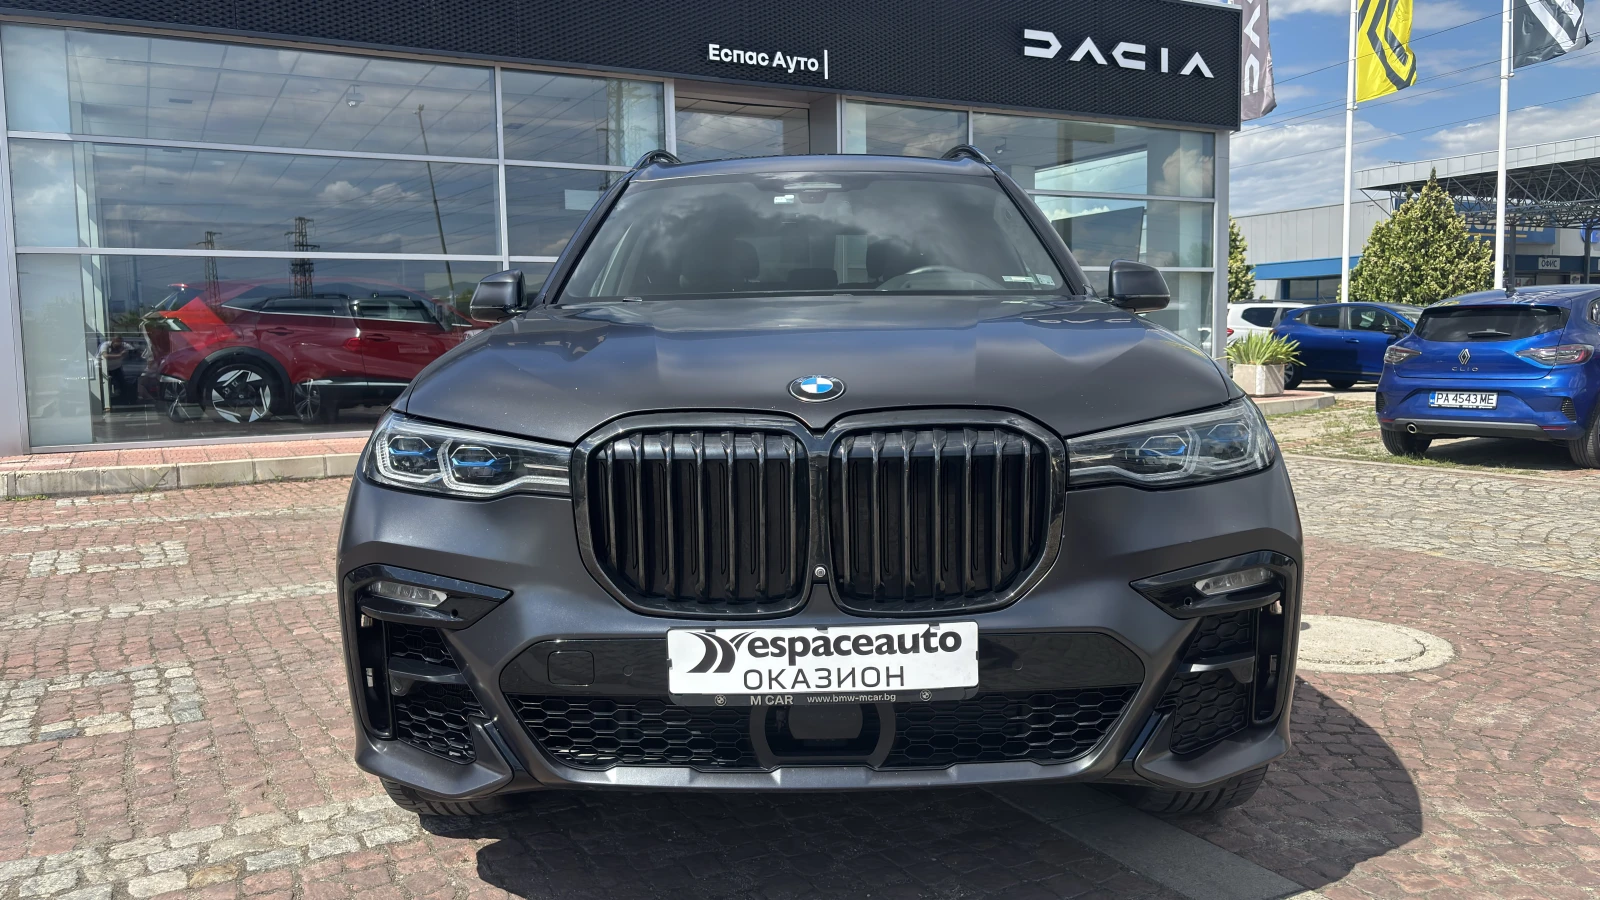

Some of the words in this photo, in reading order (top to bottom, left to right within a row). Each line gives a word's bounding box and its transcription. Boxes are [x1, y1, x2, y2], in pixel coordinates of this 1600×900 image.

[708, 43, 769, 66] Еспас
[772, 51, 819, 73] Ауто
[1024, 29, 1214, 78] DACIA
[1541, 259, 1558, 268] ОФИС
[1436, 393, 1450, 403] PA
[1451, 393, 1478, 404] 4543
[1479, 394, 1495, 404] ME
[747, 627, 962, 666] espaceauto
[743, 665, 905, 690] ОКАЗИОН
[750, 695, 762, 705] M
[764, 694, 794, 705] CAR
[807, 692, 897, 704] www.bmw-mcar.bg
